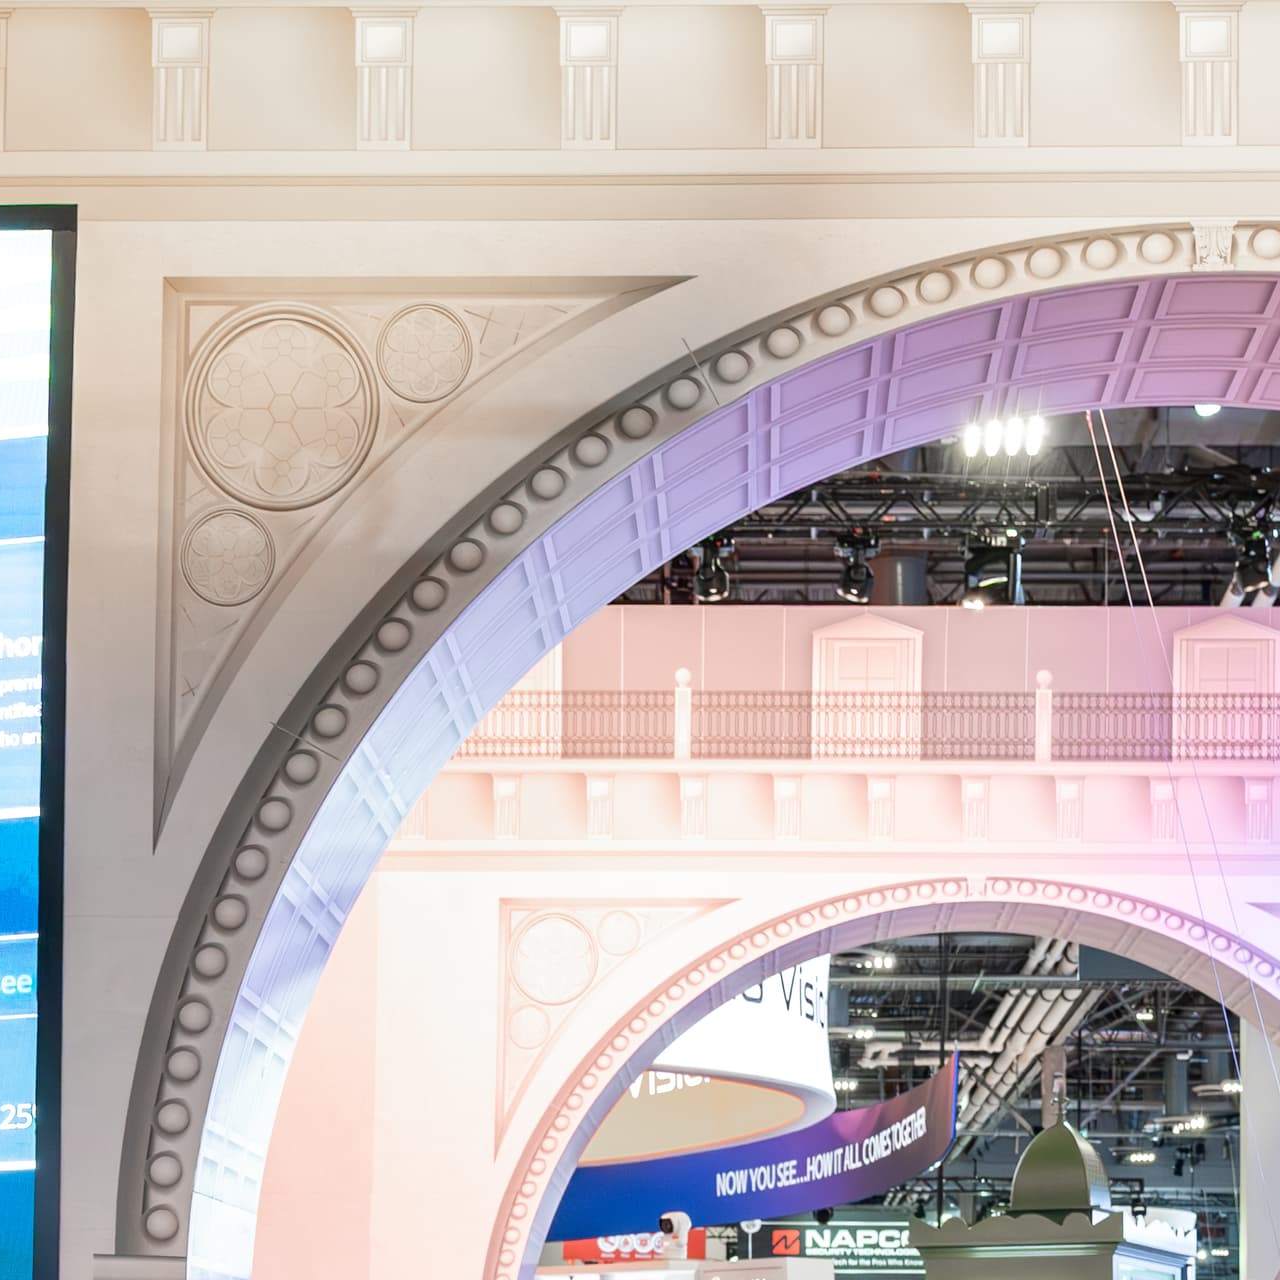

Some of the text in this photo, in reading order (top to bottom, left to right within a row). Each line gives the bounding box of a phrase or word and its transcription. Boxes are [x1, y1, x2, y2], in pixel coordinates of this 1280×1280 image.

[716, 1170, 749, 1197] NOW
[750, 1163, 777, 1193] YOU
[844, 1144, 863, 1173] ALL
[863, 1125, 892, 1165] COMES
[891, 1105, 927, 1152] TOGETHER
